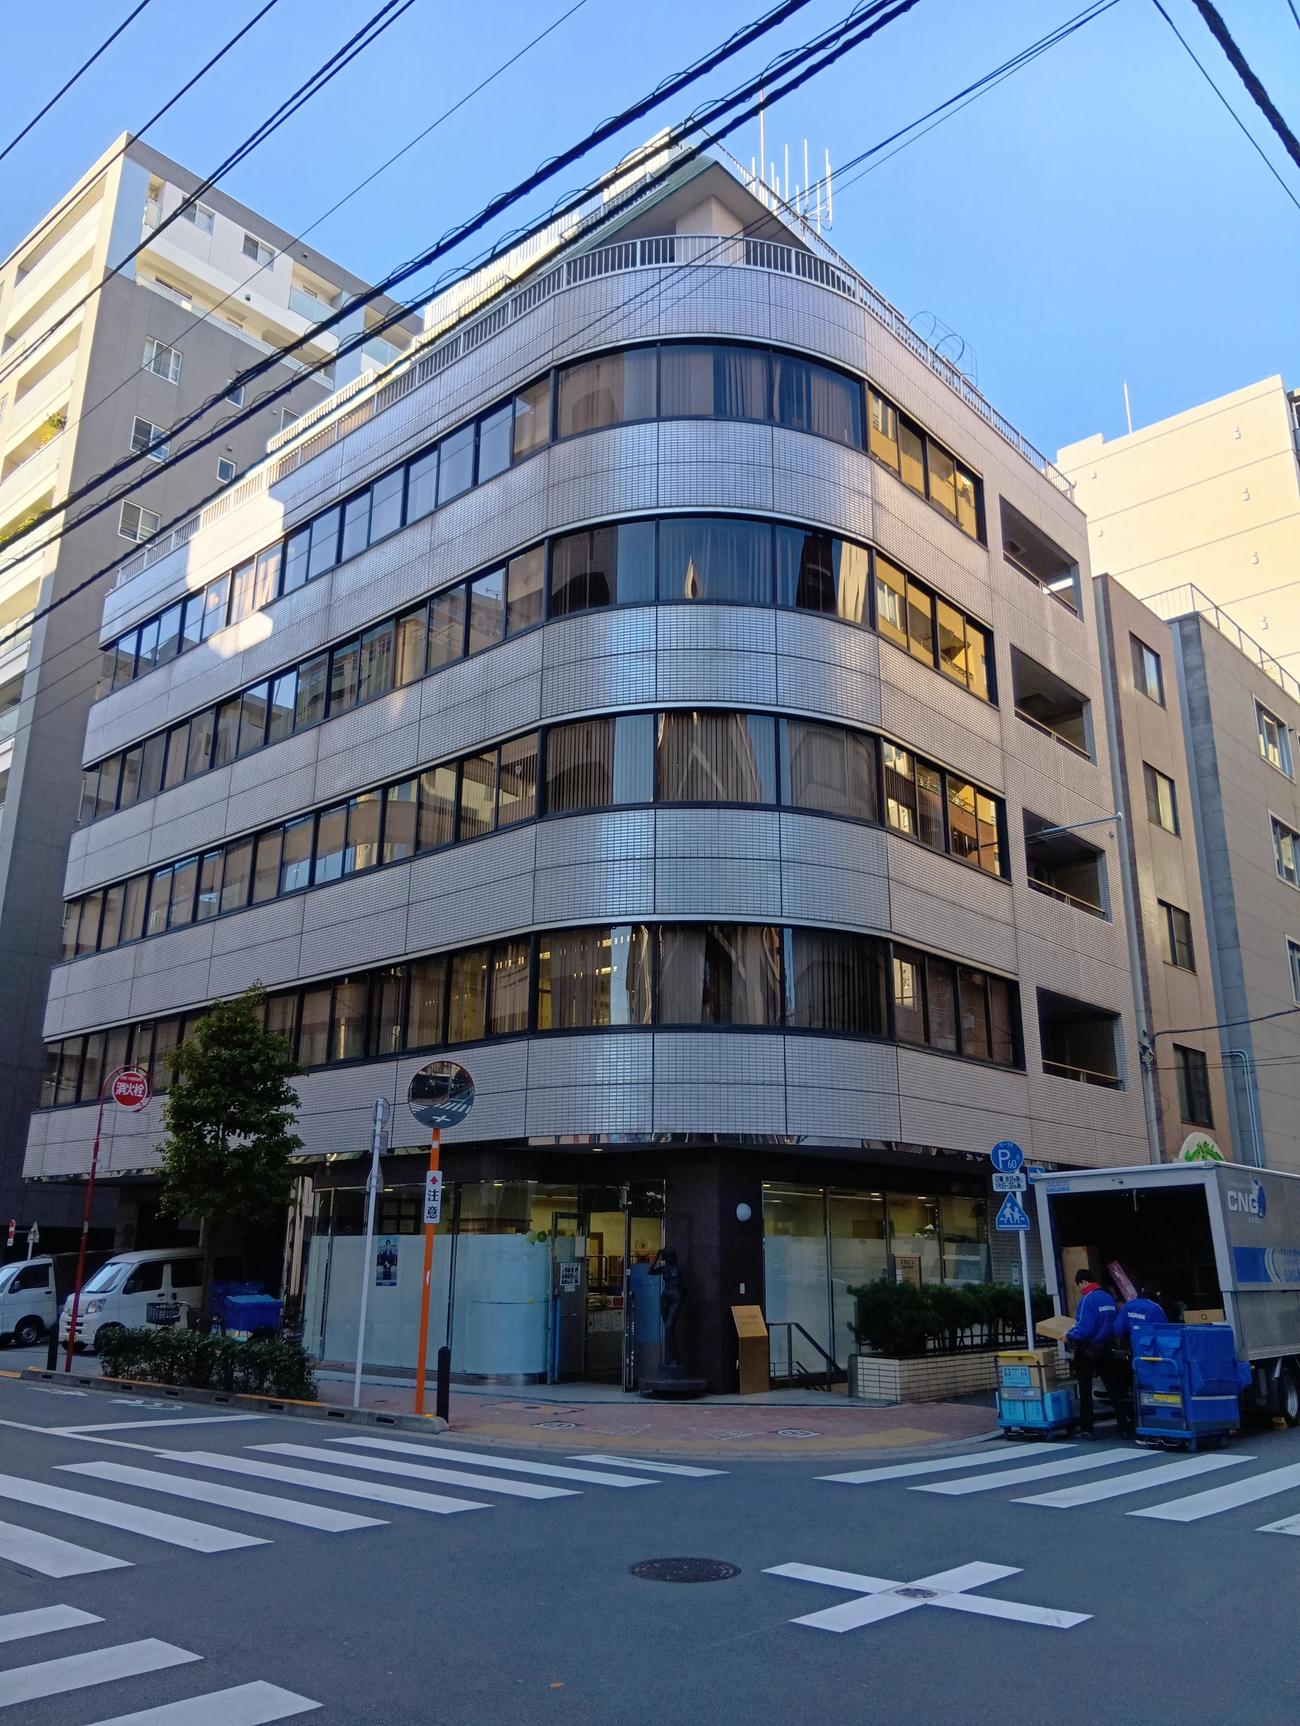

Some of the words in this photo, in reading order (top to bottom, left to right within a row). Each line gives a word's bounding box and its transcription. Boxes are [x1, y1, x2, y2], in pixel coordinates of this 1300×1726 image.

[116, 1081, 144, 1098] 消火栓
[998, 1149, 1010, 1169] P
[1007, 1160, 1018, 1169] 60
[427, 1189, 440, 1219] 注意
[1227, 1190, 1259, 1214] CNG
